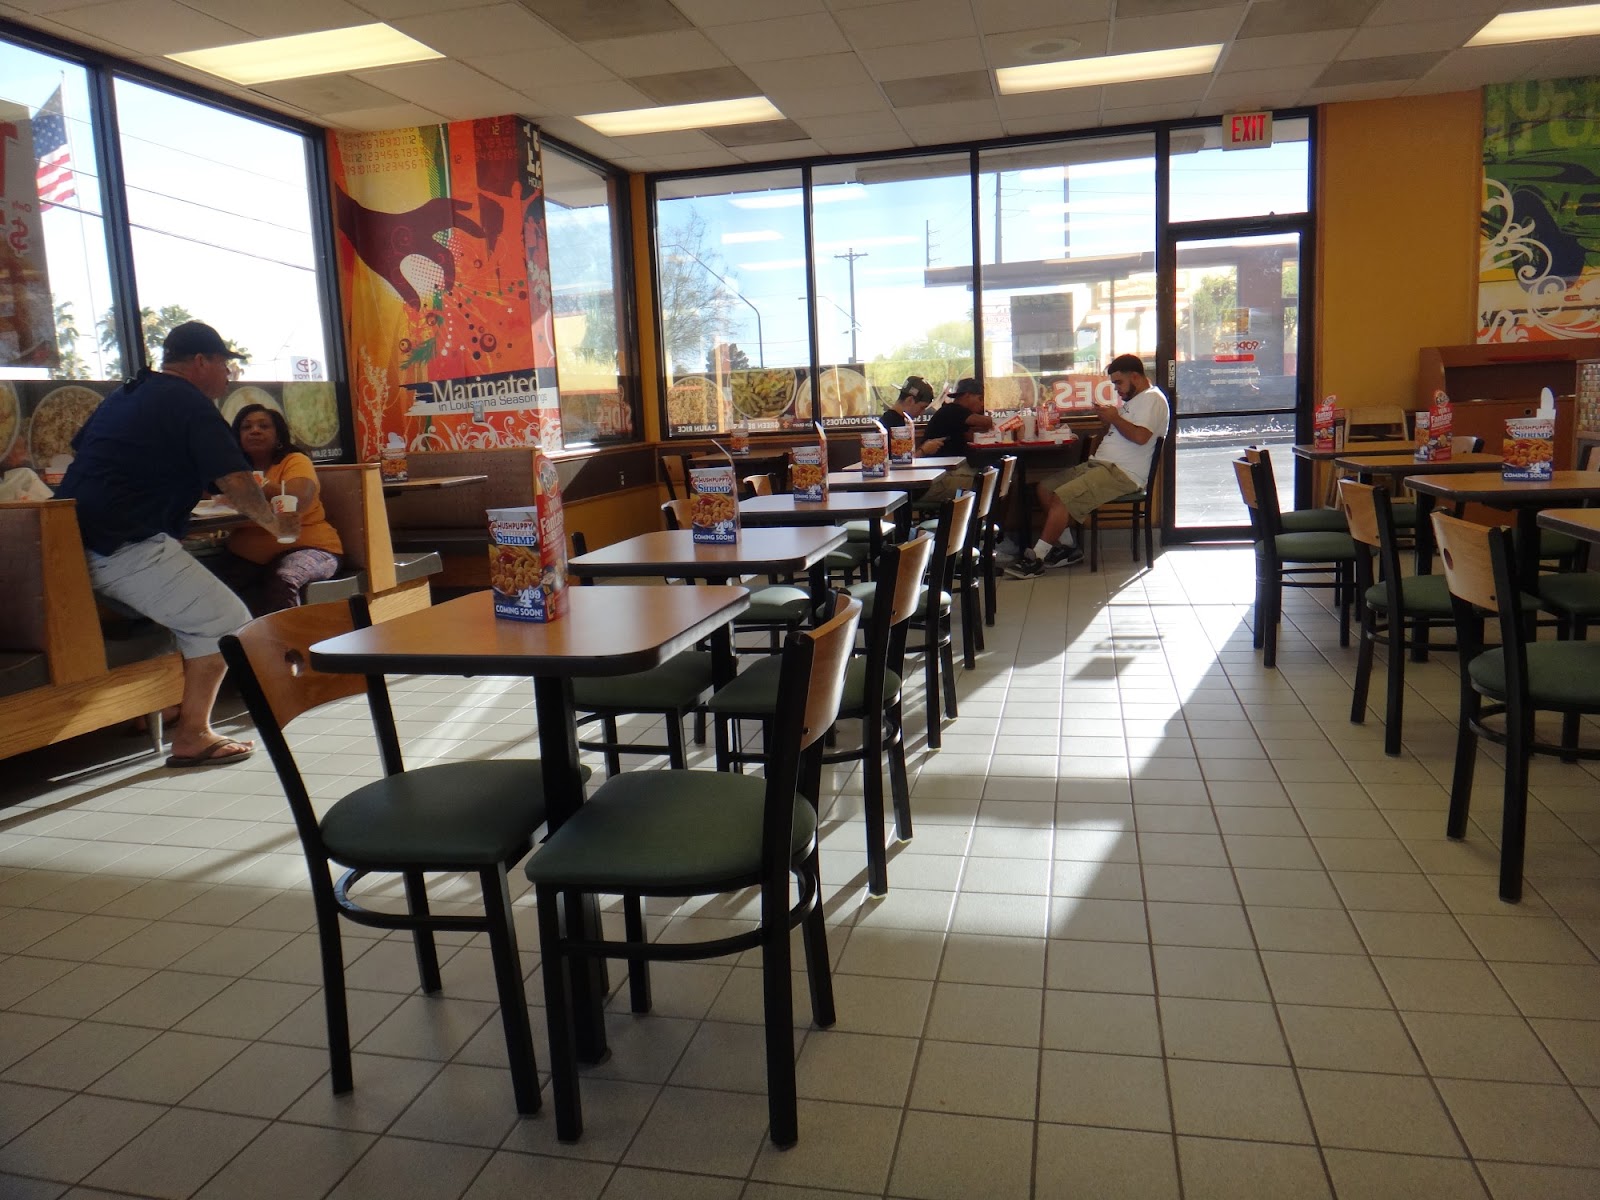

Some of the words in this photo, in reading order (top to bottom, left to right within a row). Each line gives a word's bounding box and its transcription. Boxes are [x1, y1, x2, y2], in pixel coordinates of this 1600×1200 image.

[1232, 115, 1265, 142] EXIT
[431, 370, 540, 403] Marinated
[438, 402, 447, 411] in
[499, 392, 548, 405] Seasonings
[698, 484, 731, 493] SHRIMP
[497, 522, 533, 531] HUSHPUPPY
[496, 532, 535, 545] SHRIMP
[496, 604, 519, 616] COMING
[520, 607, 543, 617] SOON!
